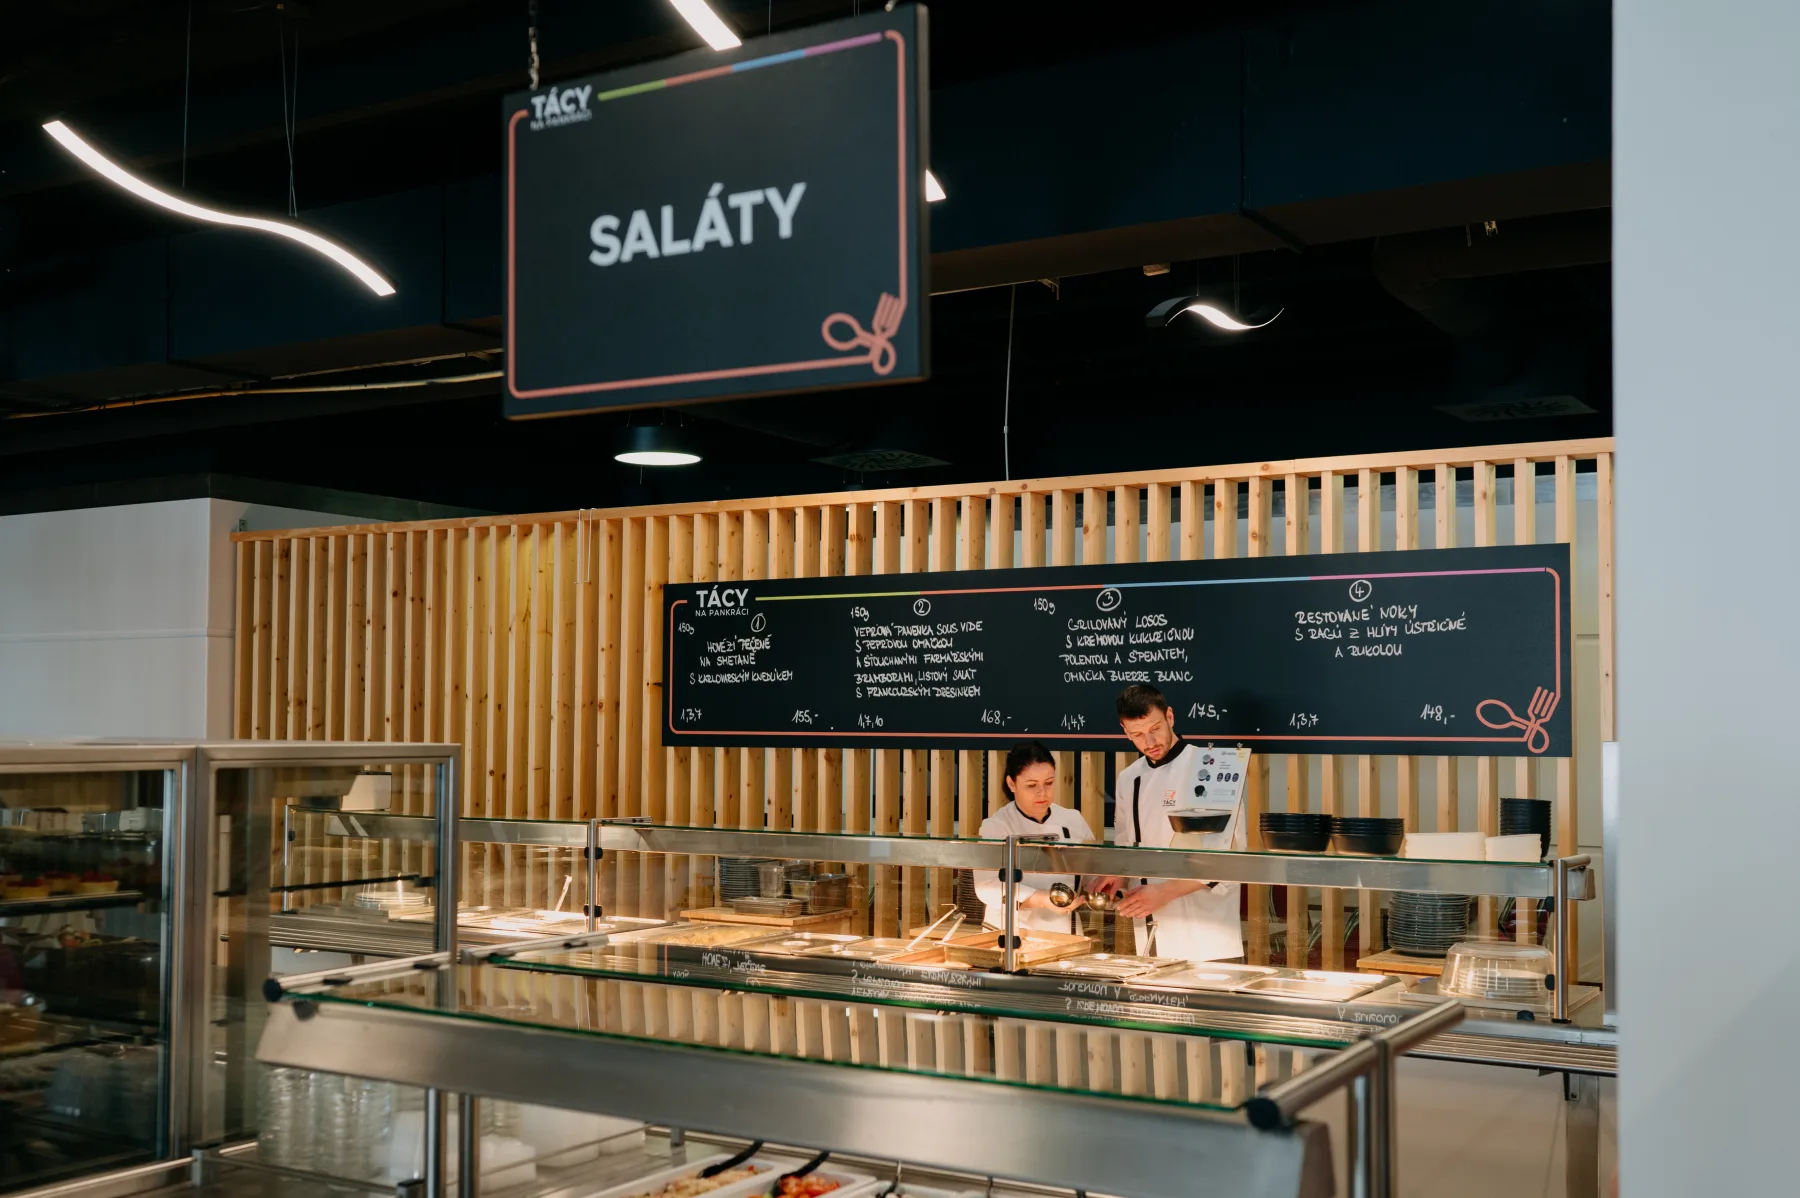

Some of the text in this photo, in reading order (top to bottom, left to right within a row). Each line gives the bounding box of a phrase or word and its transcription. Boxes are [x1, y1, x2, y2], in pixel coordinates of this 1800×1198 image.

[531, 84, 592, 119] TÁCY
[588, 182, 807, 267] SALÁTY
[696, 585, 749, 608] TÁCY
[695, 607, 749, 617] NA PANKRÁCI
[1033, 597, 1056, 615] 150g
[1380, 604, 1418, 620] NOKY
[850, 607, 870, 621] 150g
[1068, 611, 1168, 631] GRILOVANÝ LOSOS
[678, 622, 695, 635] 150g
[936, 623, 959, 636] SOUS
[960, 621, 983, 632] VIDE
[1295, 628, 1303, 641] S
[1349, 628, 1360, 639] Z
[855, 640, 862, 653] S
[1065, 635, 1073, 649] S
[1335, 643, 1403, 658] A RUKOLOU
[700, 656, 711, 667] NA
[856, 656, 862, 668] A
[1058, 654, 1109, 666] POLENTOU
[1114, 652, 1121, 664] A
[690, 673, 696, 685] S
[1107, 670, 1150, 683] BUERRE
[1154, 670, 1193, 683] BLANC
[856, 686, 862, 698] S
[980, 708, 1012, 727] 168,-
[1188, 702, 1228, 721] 175,-
[1420, 703, 1456, 725] 148,-
[1289, 712, 1319, 729] 1,3,7
